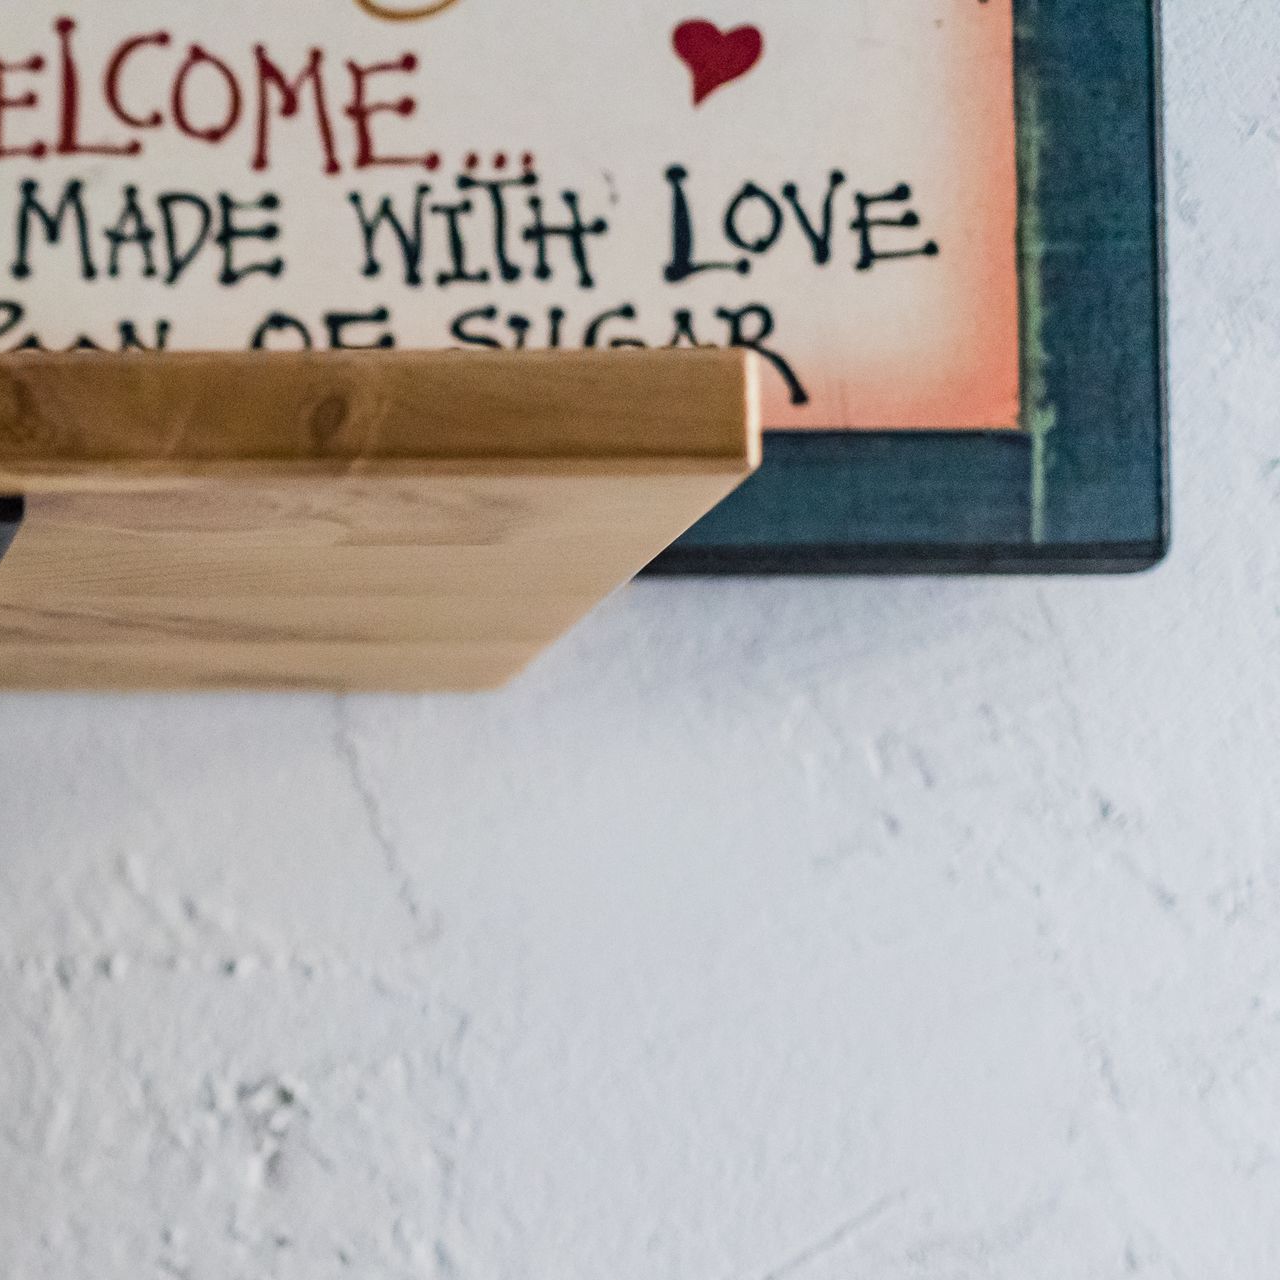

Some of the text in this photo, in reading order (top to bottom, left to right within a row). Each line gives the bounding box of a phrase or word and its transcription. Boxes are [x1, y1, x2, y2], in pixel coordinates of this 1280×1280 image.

[10, 179, 285, 285] MADE
[348, 172, 608, 288] WITH
[664, 165, 938, 282] LOVE
